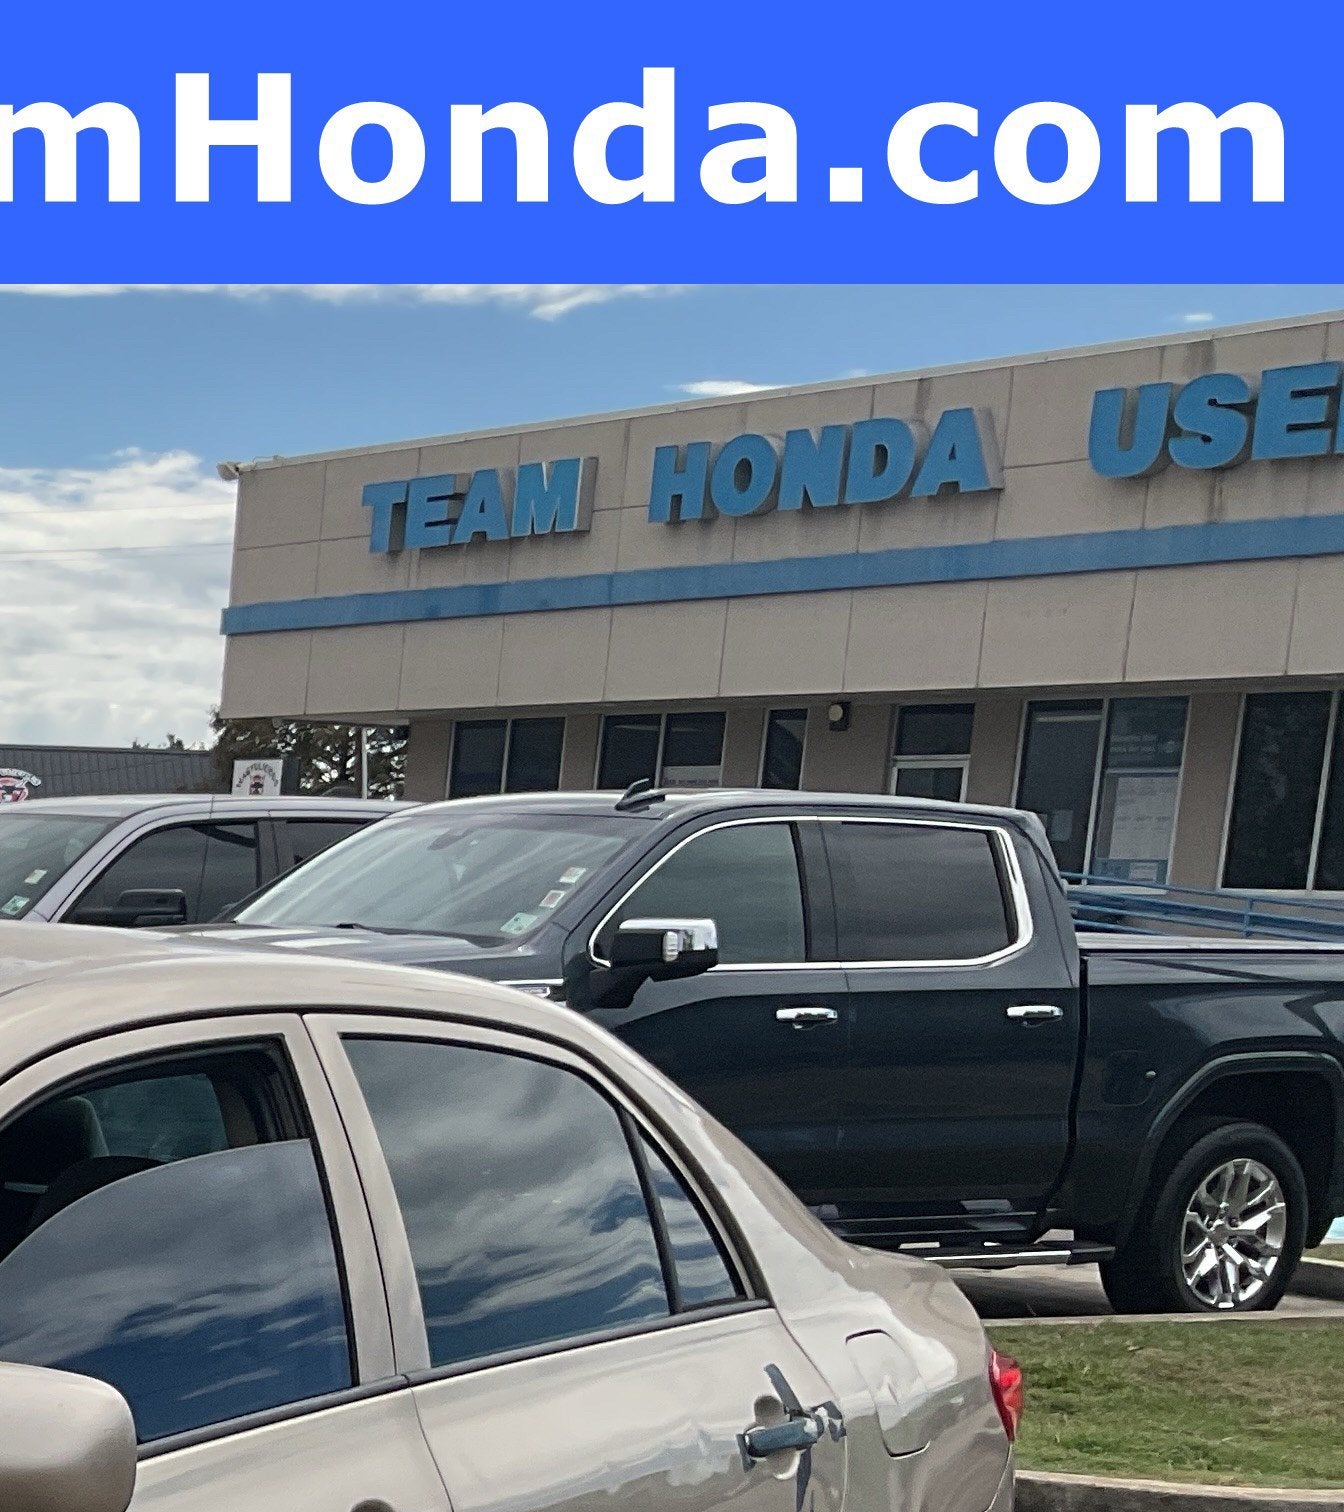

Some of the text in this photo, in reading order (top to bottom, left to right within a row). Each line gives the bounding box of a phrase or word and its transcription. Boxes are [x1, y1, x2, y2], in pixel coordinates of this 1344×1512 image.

[362, 360, 1344, 554] TEAM HONDA USE
